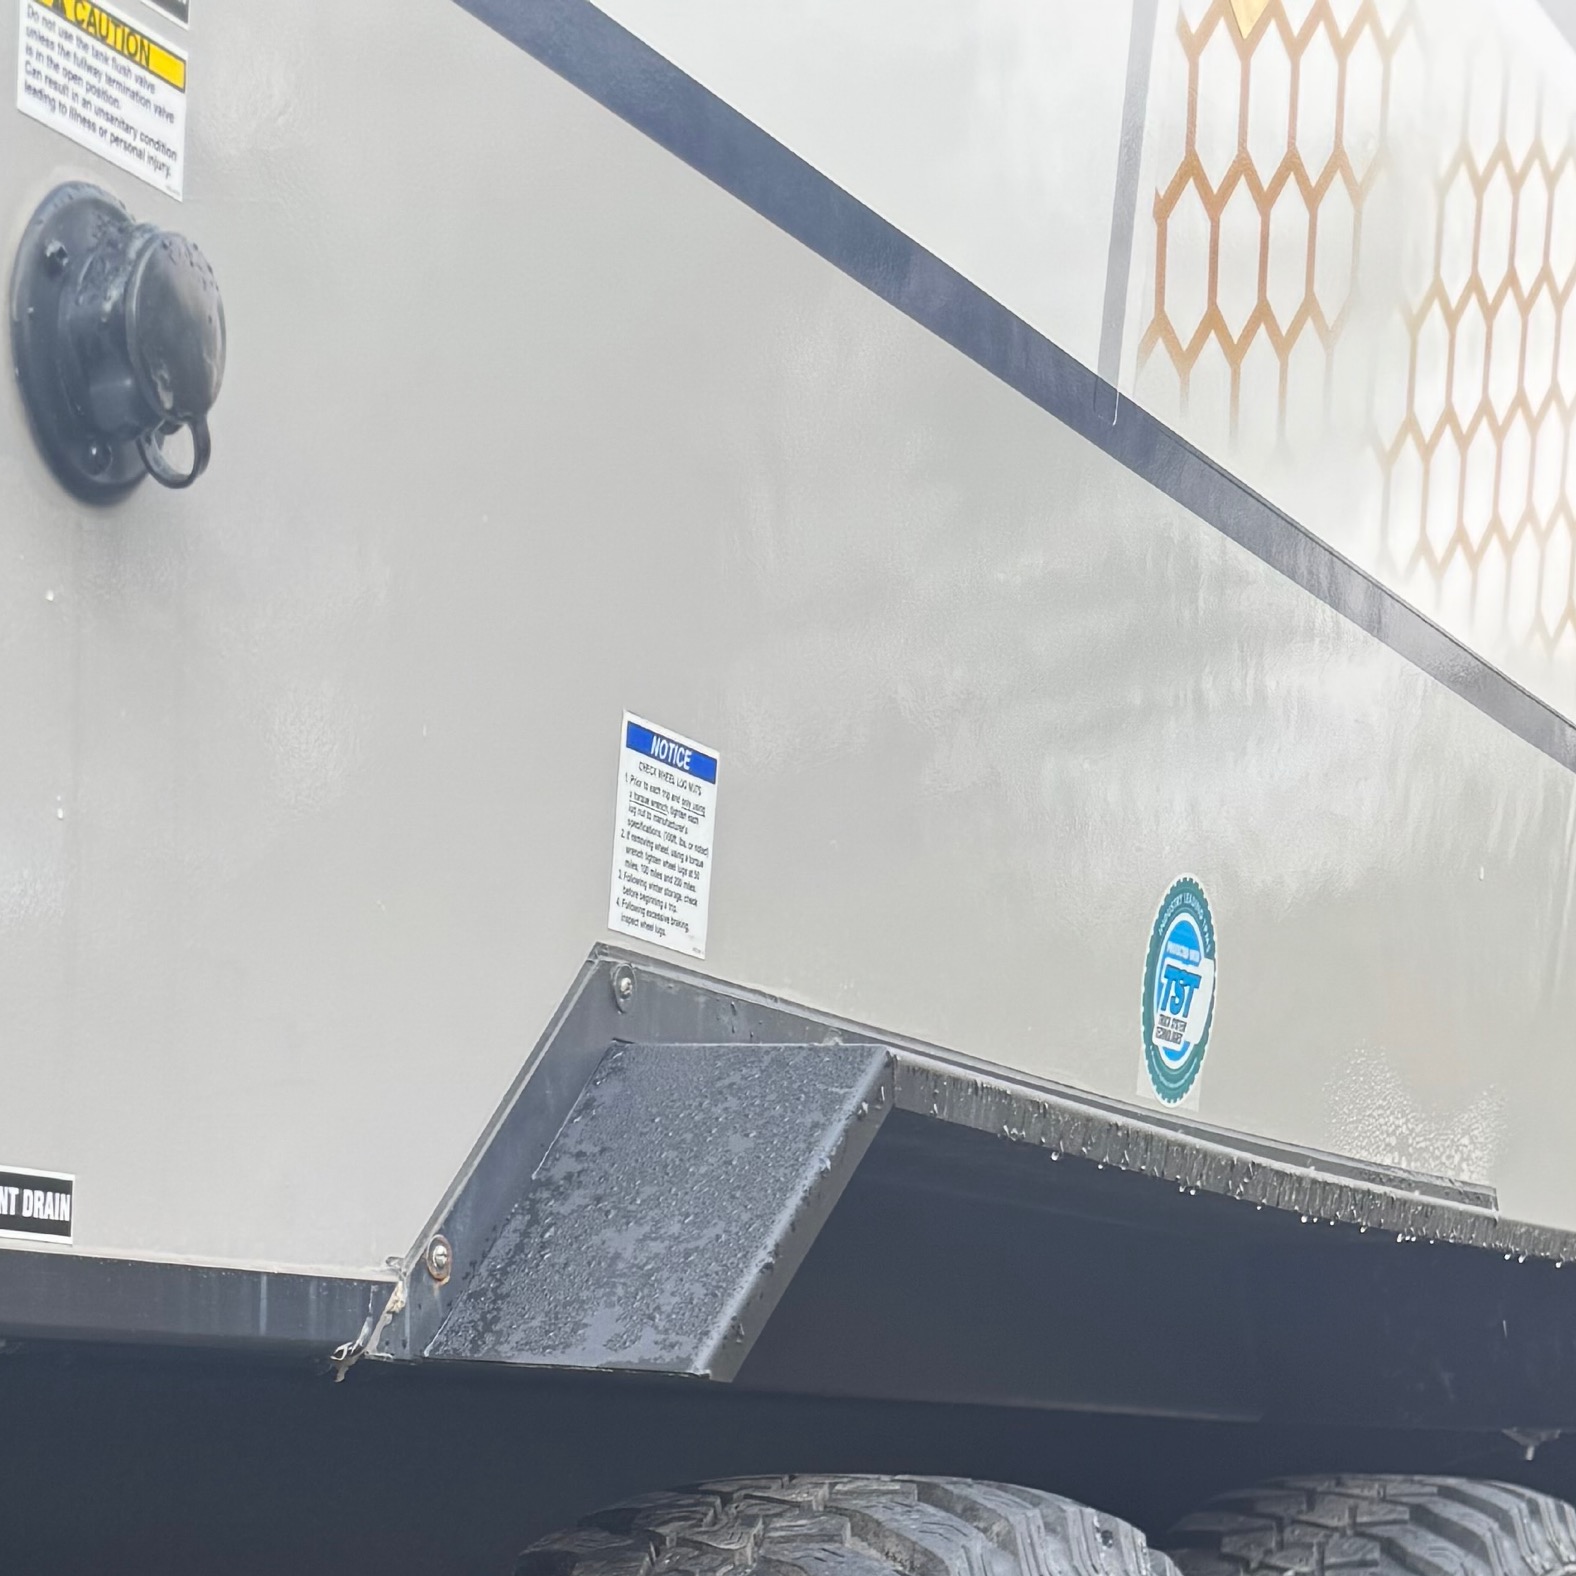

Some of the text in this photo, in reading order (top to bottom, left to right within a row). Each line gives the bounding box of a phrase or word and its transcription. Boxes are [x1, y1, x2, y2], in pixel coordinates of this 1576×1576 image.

[26, 4, 155, 94] Do not use the tank flush valve
[74, 0, 151, 68] CAUTION
[25, 44, 120, 109] is in the open position.
[26, 27, 55, 50] unless
[57, 42, 71, 59] the
[104, 73, 151, 108] termination
[153, 104, 174, 124] valve
[24, 60, 177, 160] Can result in an unsanitary condition
[24, 80, 171, 179] leading to illness or personal injury.
[650, 735, 692, 771] NOTICE
[1160, 964, 1202, 1018] TST
[22, 1189, 70, 1222] DRAIN
